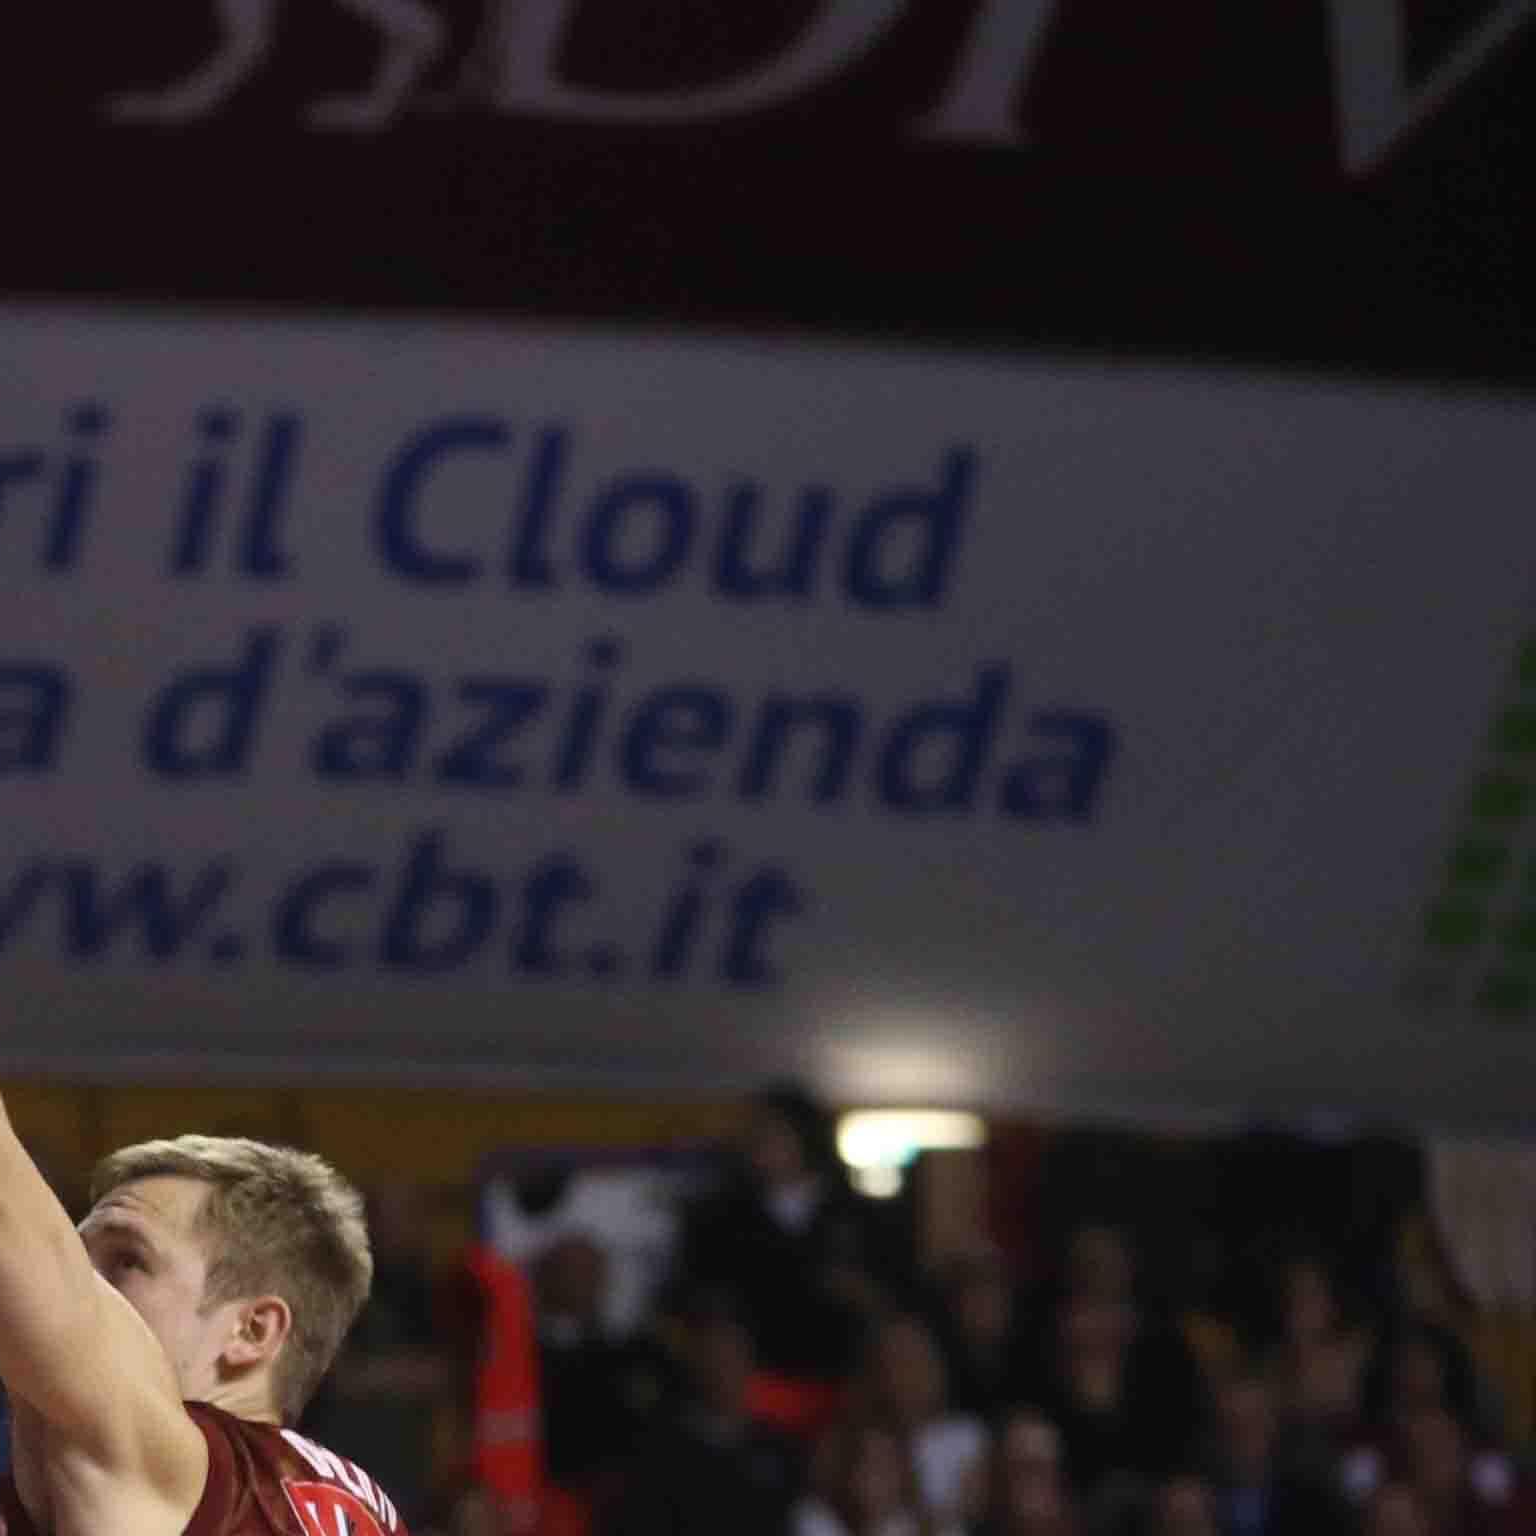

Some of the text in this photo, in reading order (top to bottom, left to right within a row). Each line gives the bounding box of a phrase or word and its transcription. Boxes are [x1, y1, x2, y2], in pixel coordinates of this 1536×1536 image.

[166, 403, 304, 580] il
[368, 412, 978, 612] Cloud
[141, 622, 1120, 826] d'azienda
